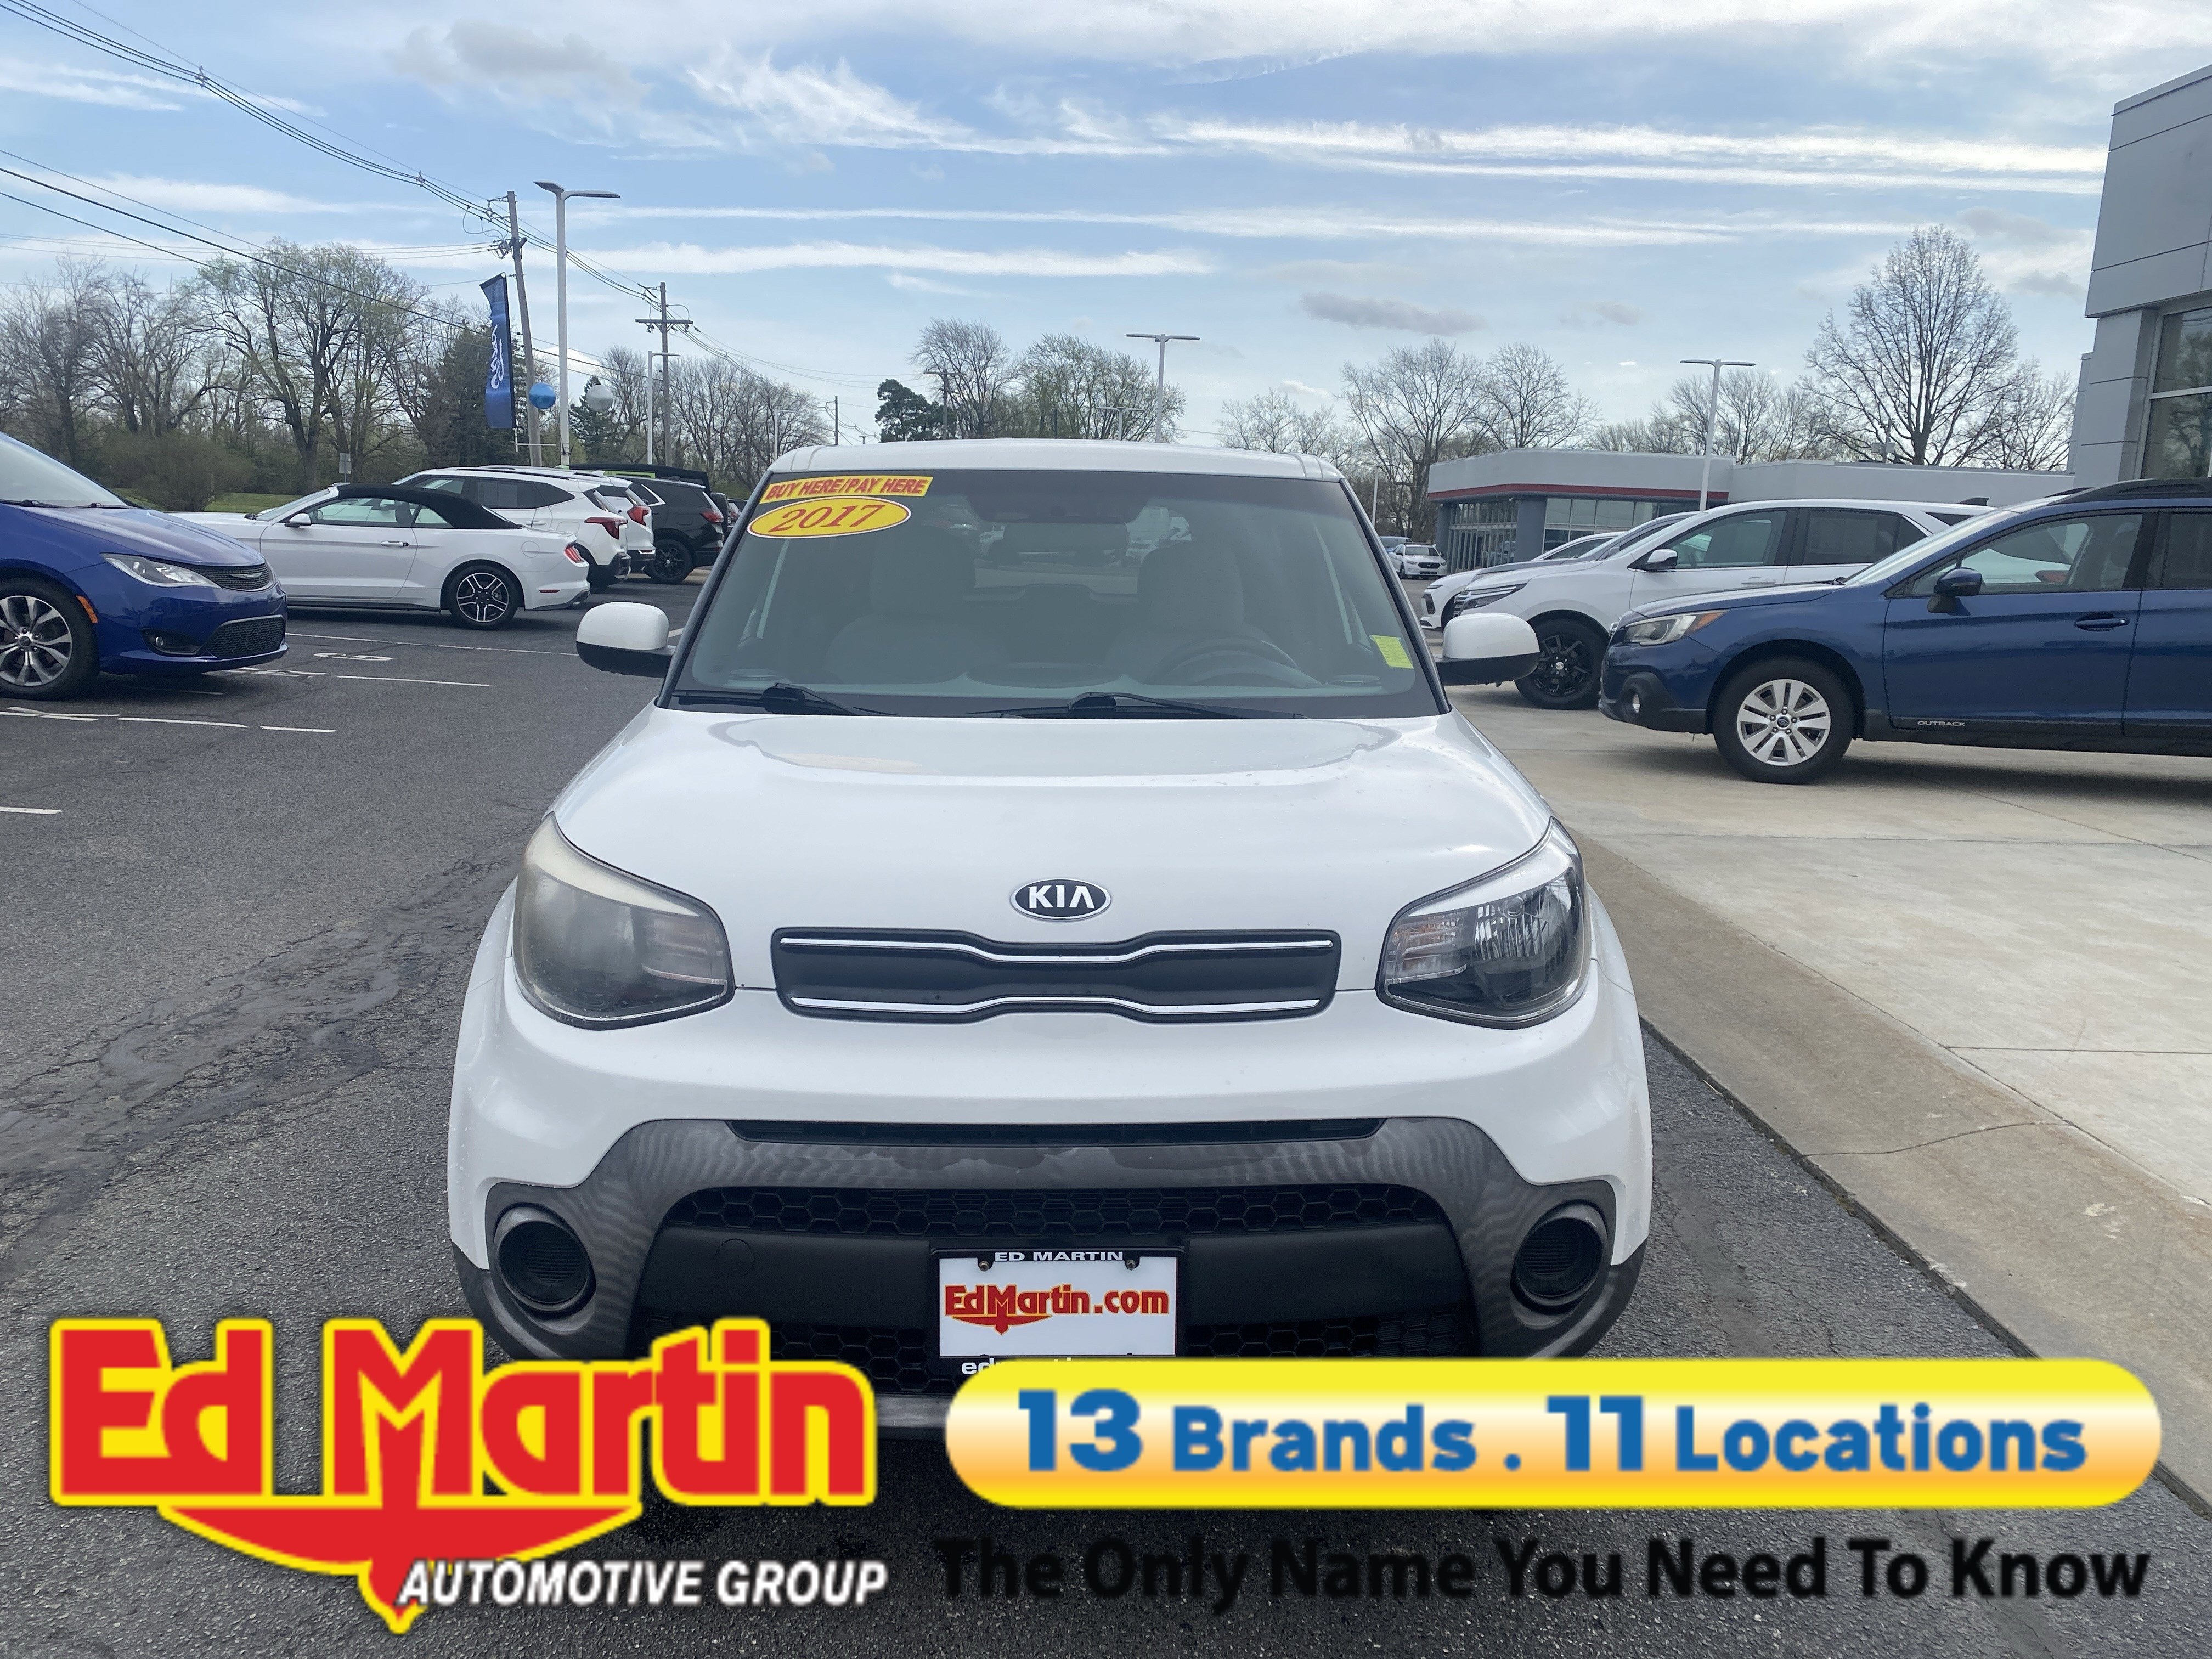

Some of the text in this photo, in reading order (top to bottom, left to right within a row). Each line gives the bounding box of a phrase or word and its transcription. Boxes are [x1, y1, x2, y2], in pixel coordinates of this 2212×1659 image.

[766, 478, 929, 500] BUY HERE/PAY HERE
[768, 504, 885, 533] 2017
[1028, 885, 1095, 909] KIA
[994, 1251, 1124, 1262] ED MARTIN
